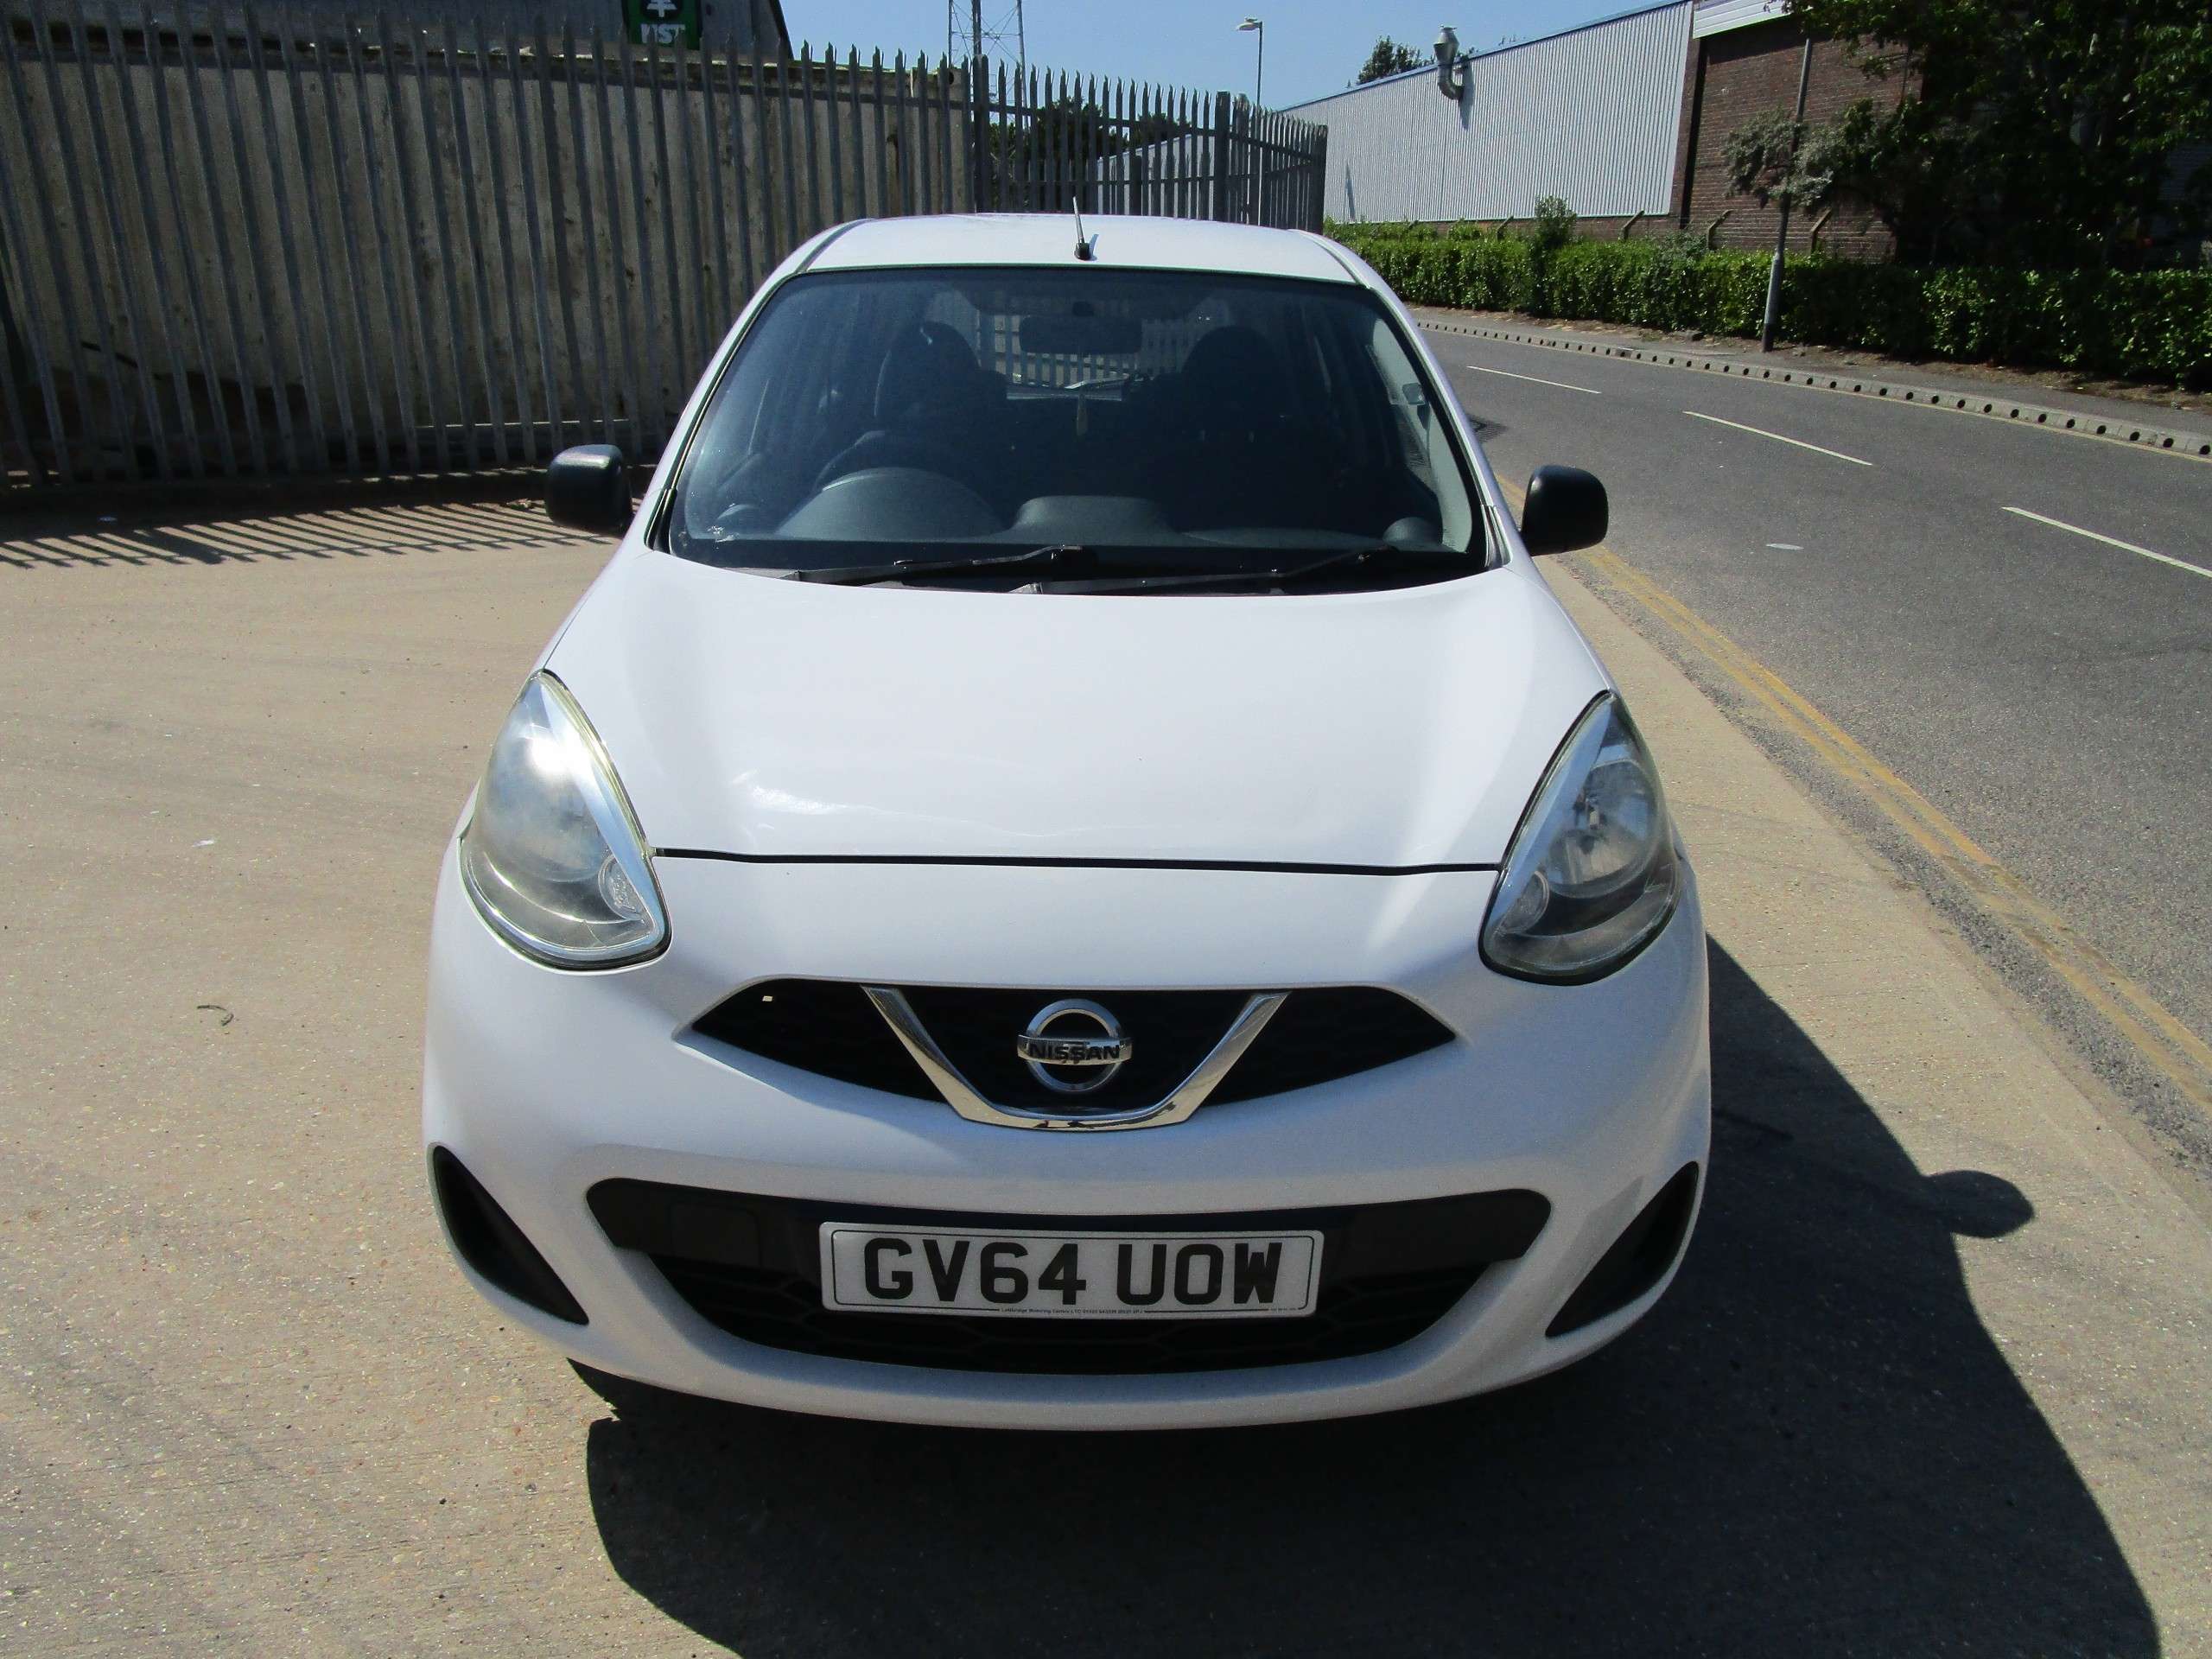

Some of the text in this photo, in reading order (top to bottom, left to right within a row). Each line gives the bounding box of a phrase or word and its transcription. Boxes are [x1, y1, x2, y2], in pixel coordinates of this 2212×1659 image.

[1027, 1043, 1121, 1061] NISSAN
[864, 1237, 1283, 1306] GV64 UOW
